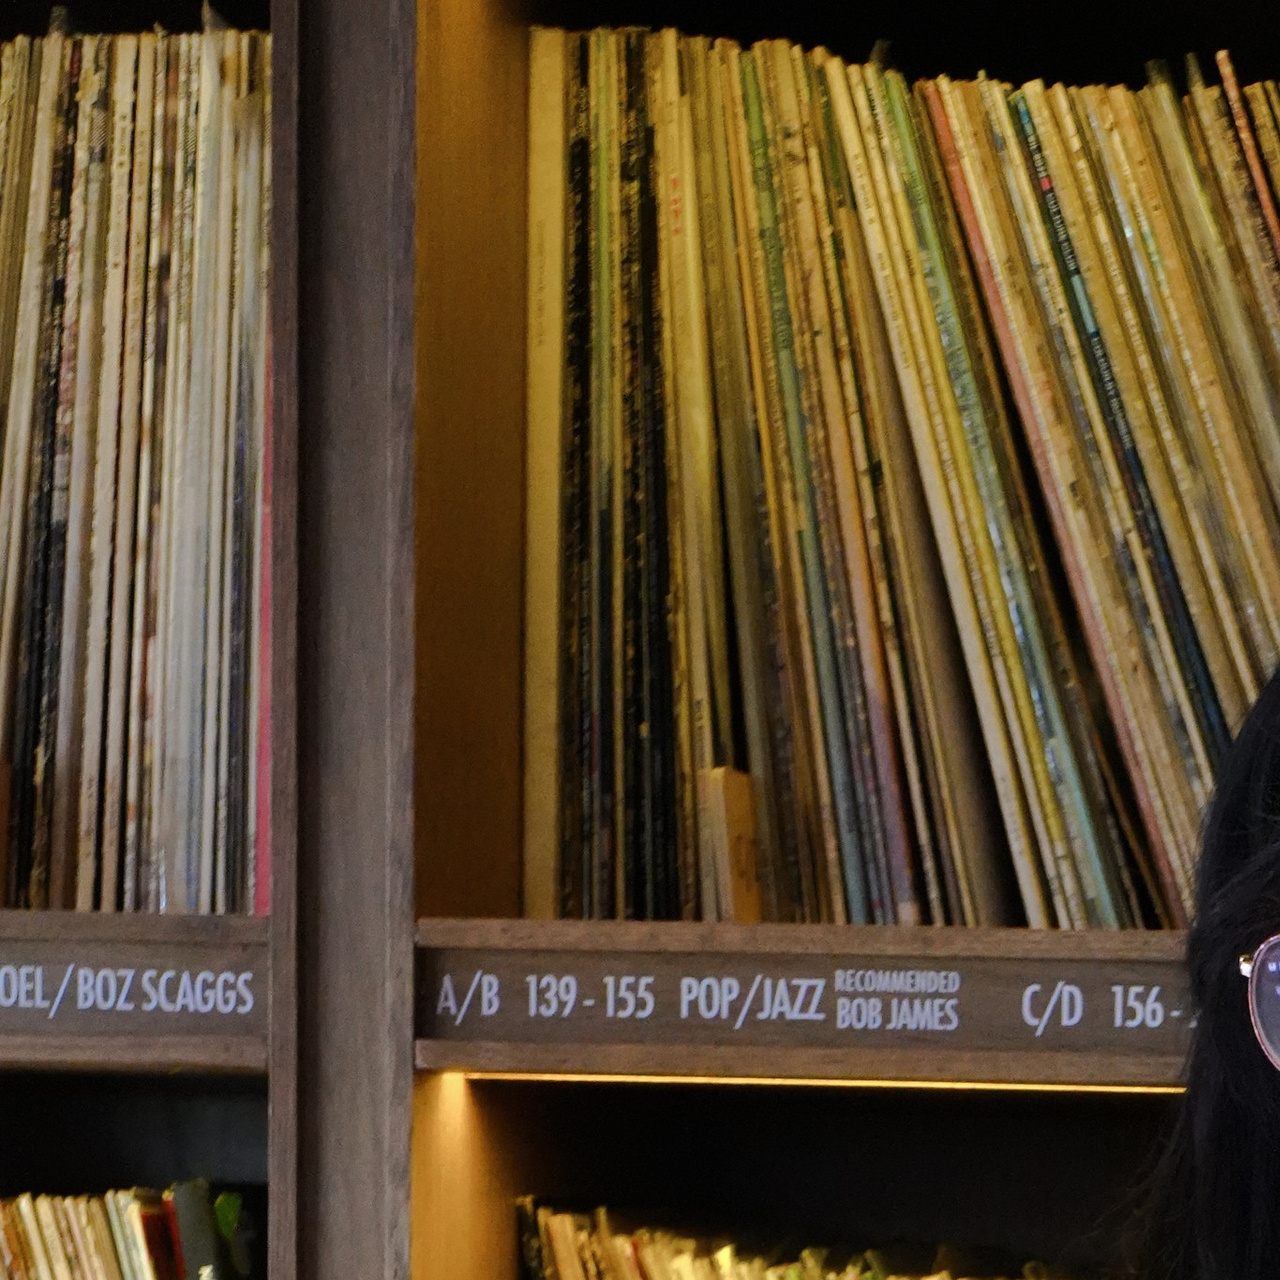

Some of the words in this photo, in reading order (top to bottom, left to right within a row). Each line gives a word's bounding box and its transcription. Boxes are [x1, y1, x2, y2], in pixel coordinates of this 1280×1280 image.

[141, 971, 254, 1014] SCAGGS
[437, 970, 500, 1024] A/B
[526, 974, 577, 1017] 139
[603, 975, 654, 1018] 155
[680, 974, 827, 1030] POP/JAZZ
[835, 969, 960, 993] RECOMMENDED
[836, 998, 882, 1030] BOB
[886, 998, 958, 1031] JAMES
[1022, 981, 1084, 1037] C/D
[1112, 985, 1164, 1028] 156
